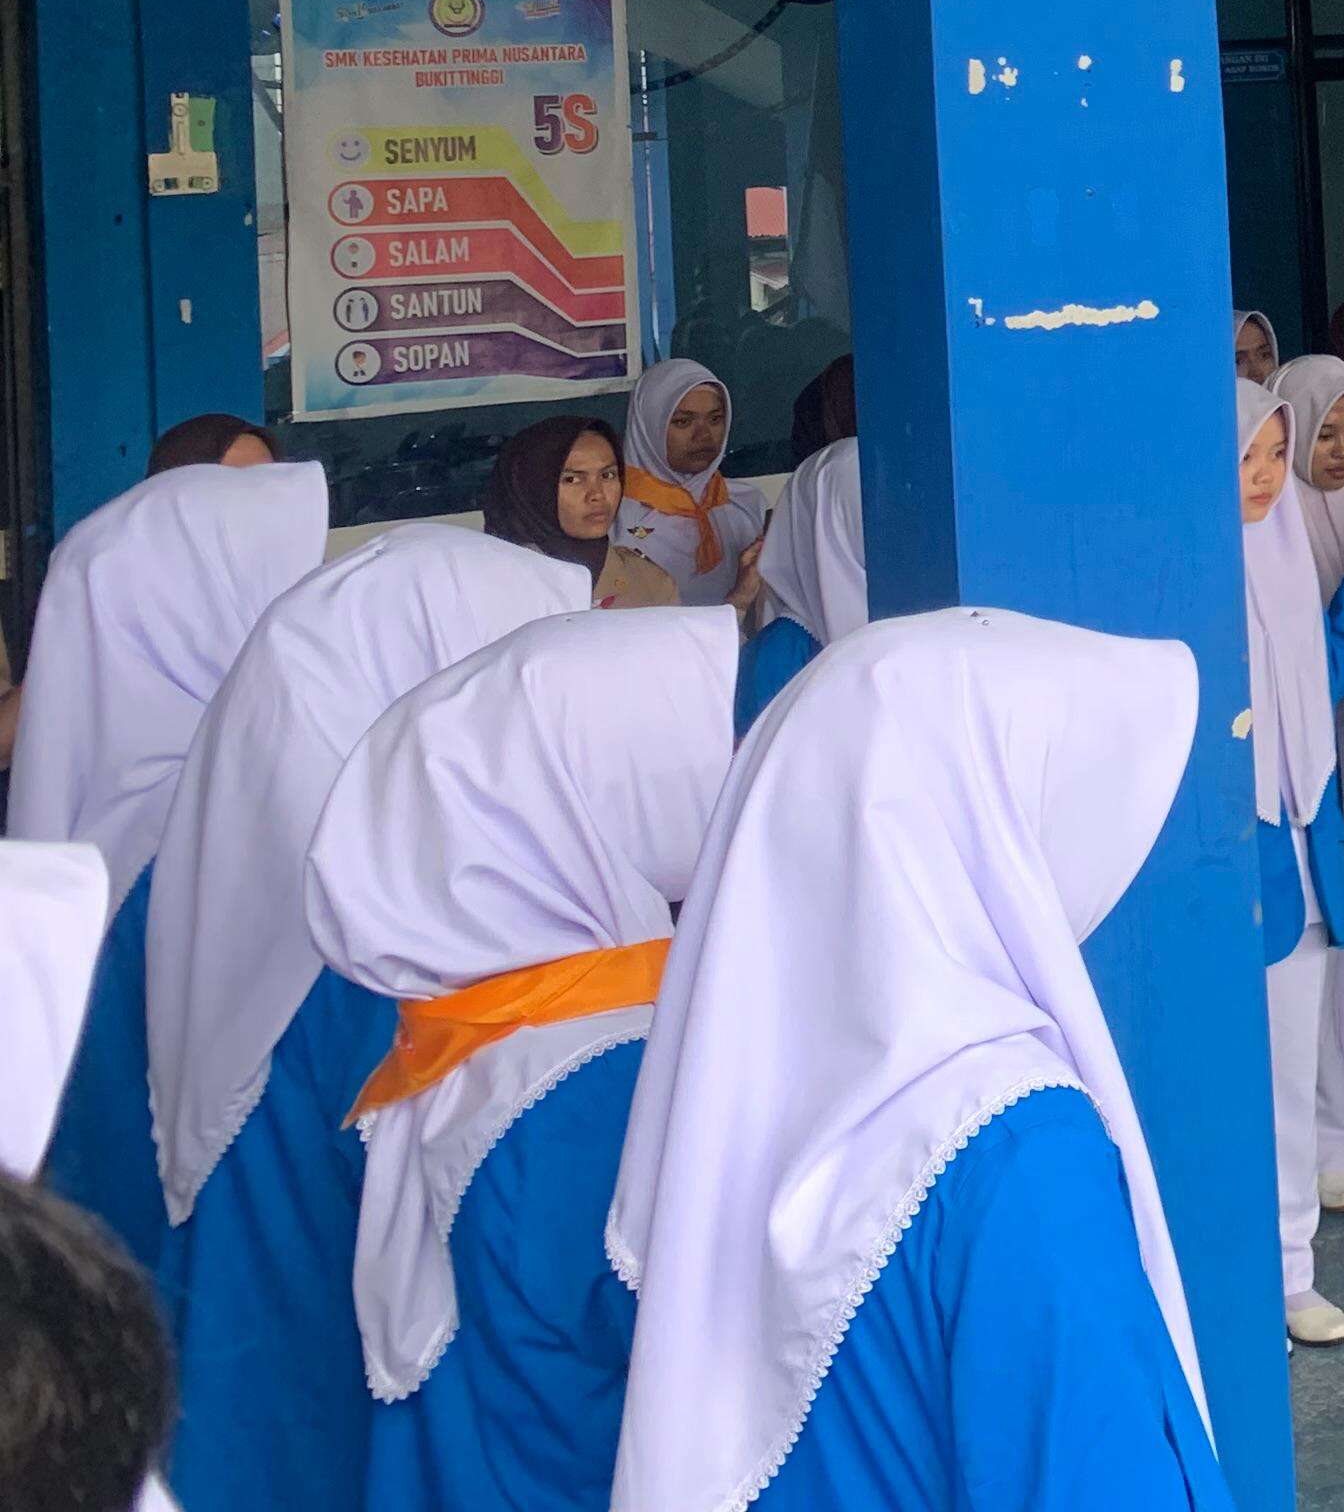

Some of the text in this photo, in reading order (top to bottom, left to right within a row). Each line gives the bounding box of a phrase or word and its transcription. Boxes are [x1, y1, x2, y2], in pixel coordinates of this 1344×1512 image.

[325, 45, 585, 68] SMK KESEHATAN PRIMA NUSANTARA
[416, 69, 504, 88] BUKITTINGGI
[534, 94, 599, 155] 5S
[384, 135, 477, 165] SENYUM
[386, 186, 449, 216] SAPA
[388, 236, 471, 267] SALAM
[390, 287, 483, 321] SANTUN
[392, 340, 471, 374] SOPAN
